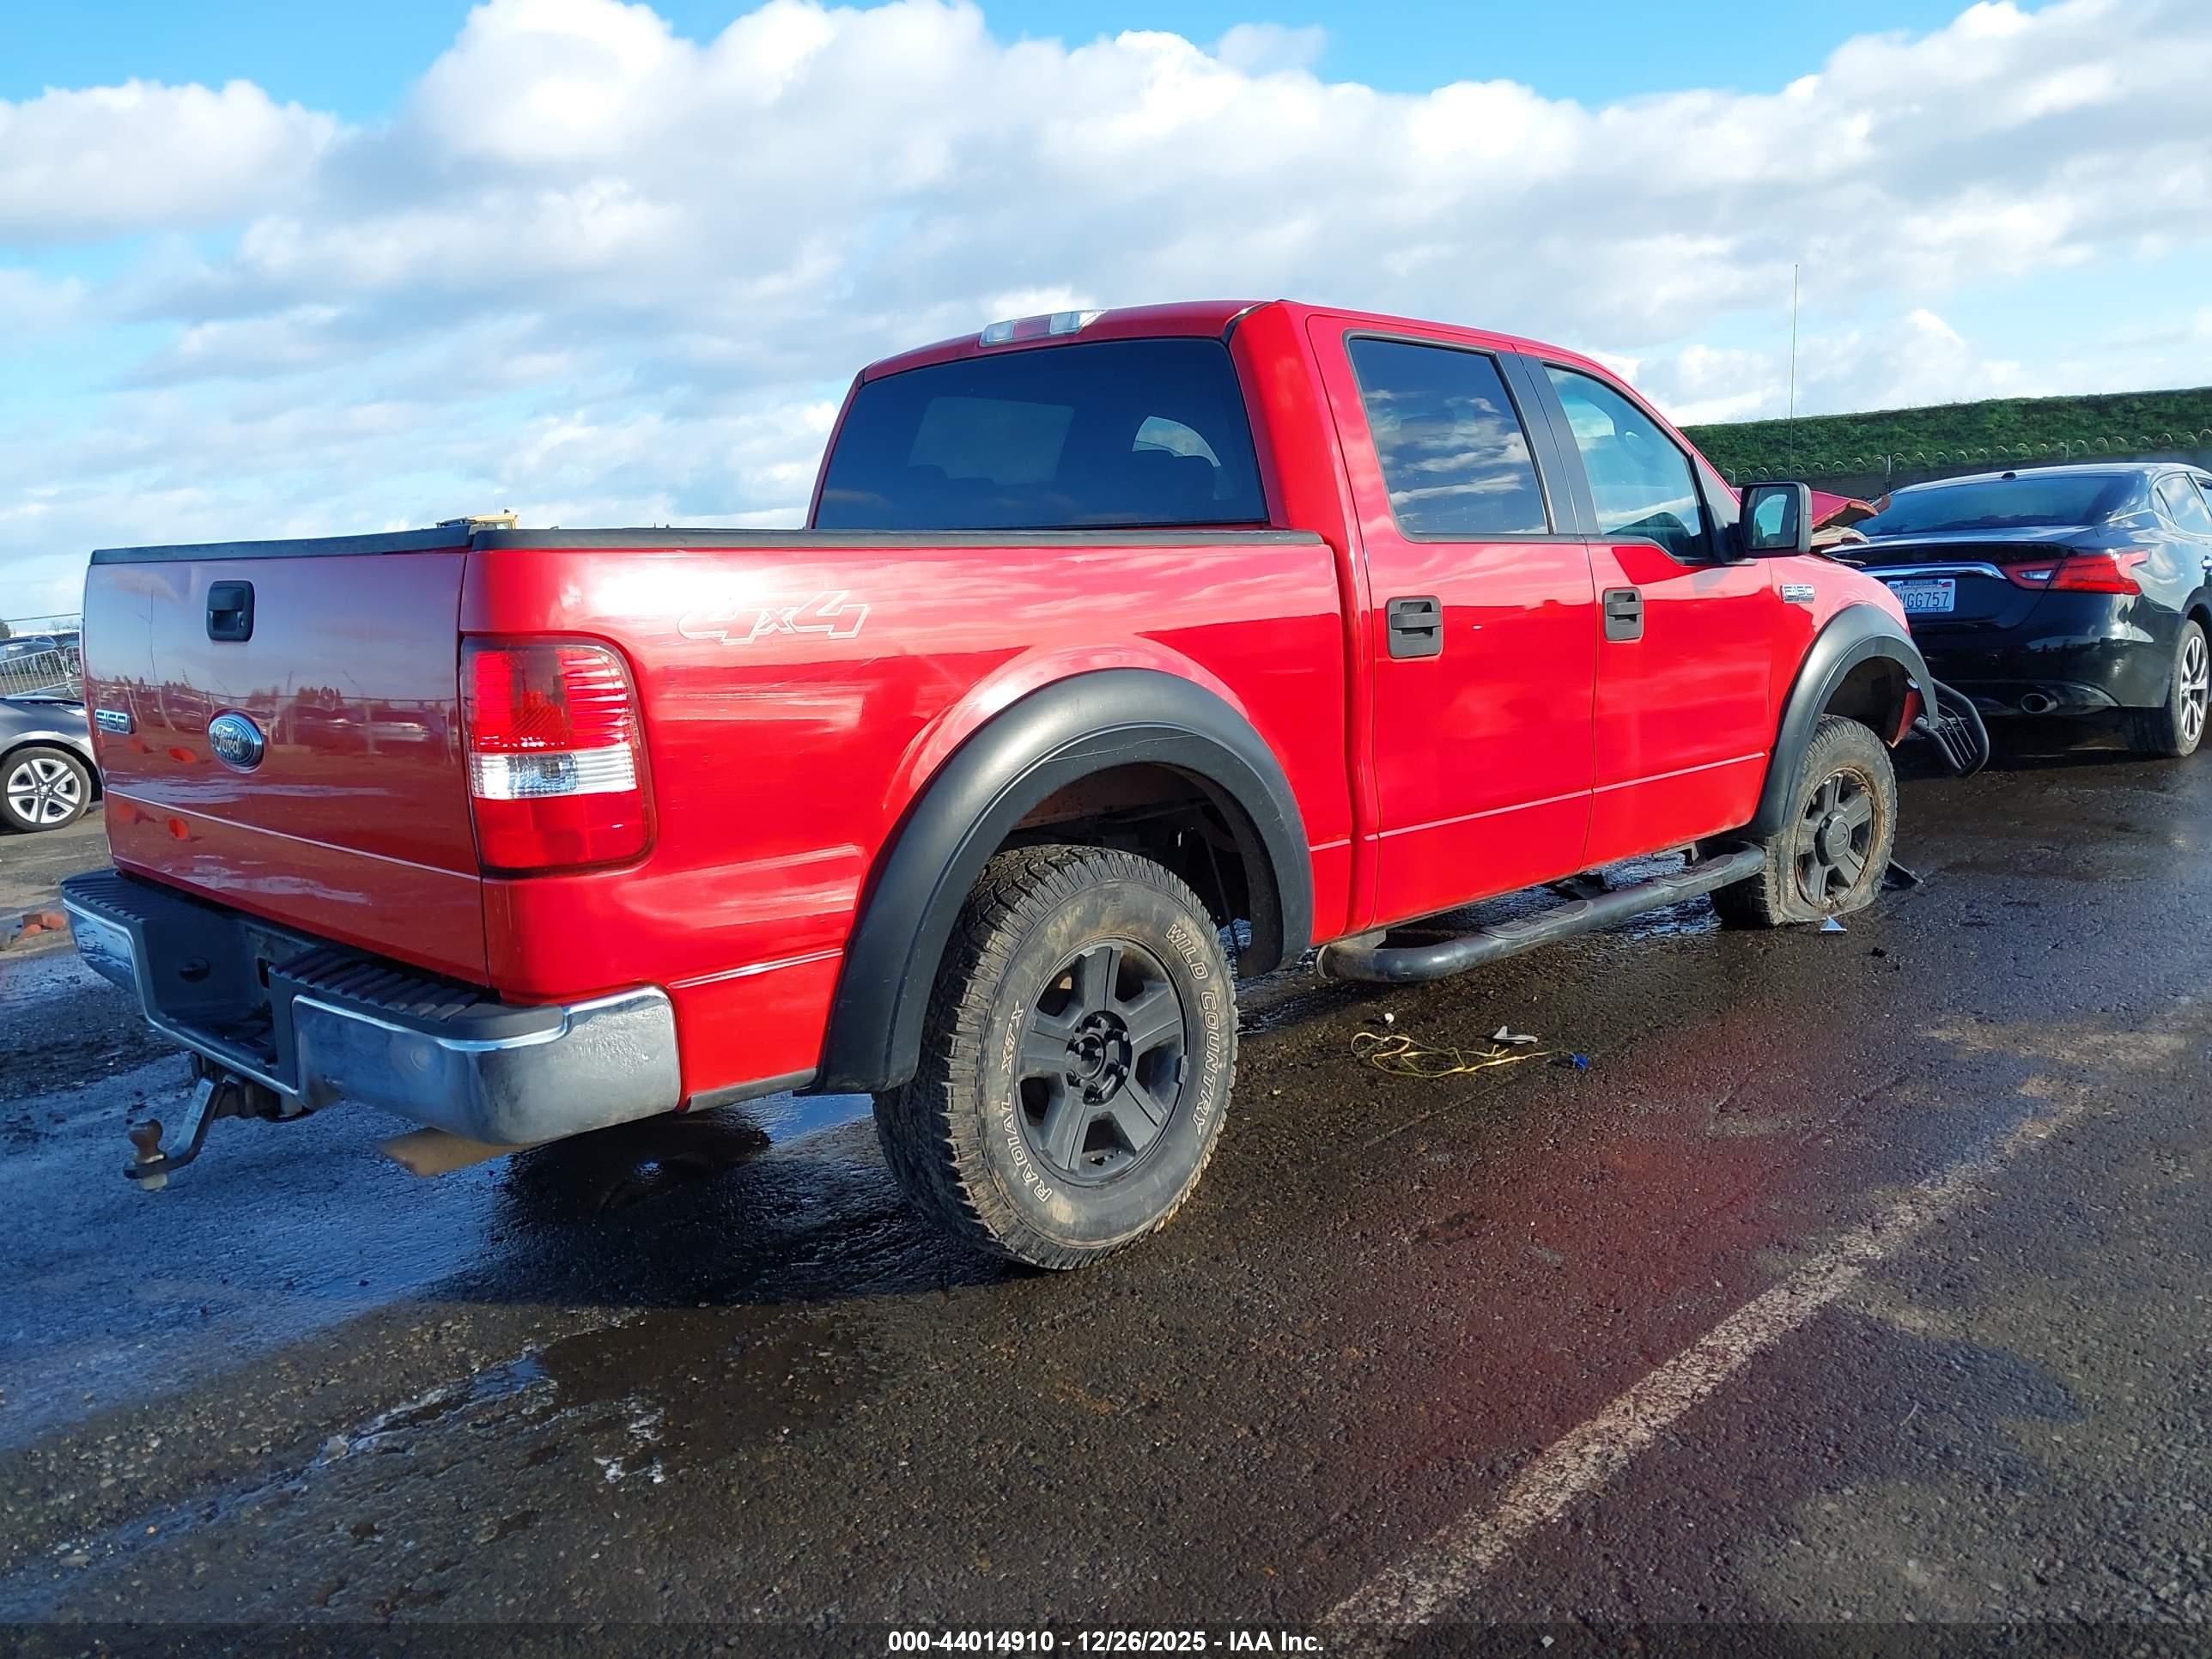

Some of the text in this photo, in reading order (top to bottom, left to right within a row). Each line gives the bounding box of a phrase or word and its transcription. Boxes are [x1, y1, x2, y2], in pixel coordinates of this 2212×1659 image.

[678, 590, 871, 646] 4x4
[1899, 591, 1949, 608] VGG757
[215, 724, 241, 756] Ford
[1164, 923, 1220, 1136] WILD COUNTRY
[1000, 1000, 1053, 1202] RADIAL XTX
